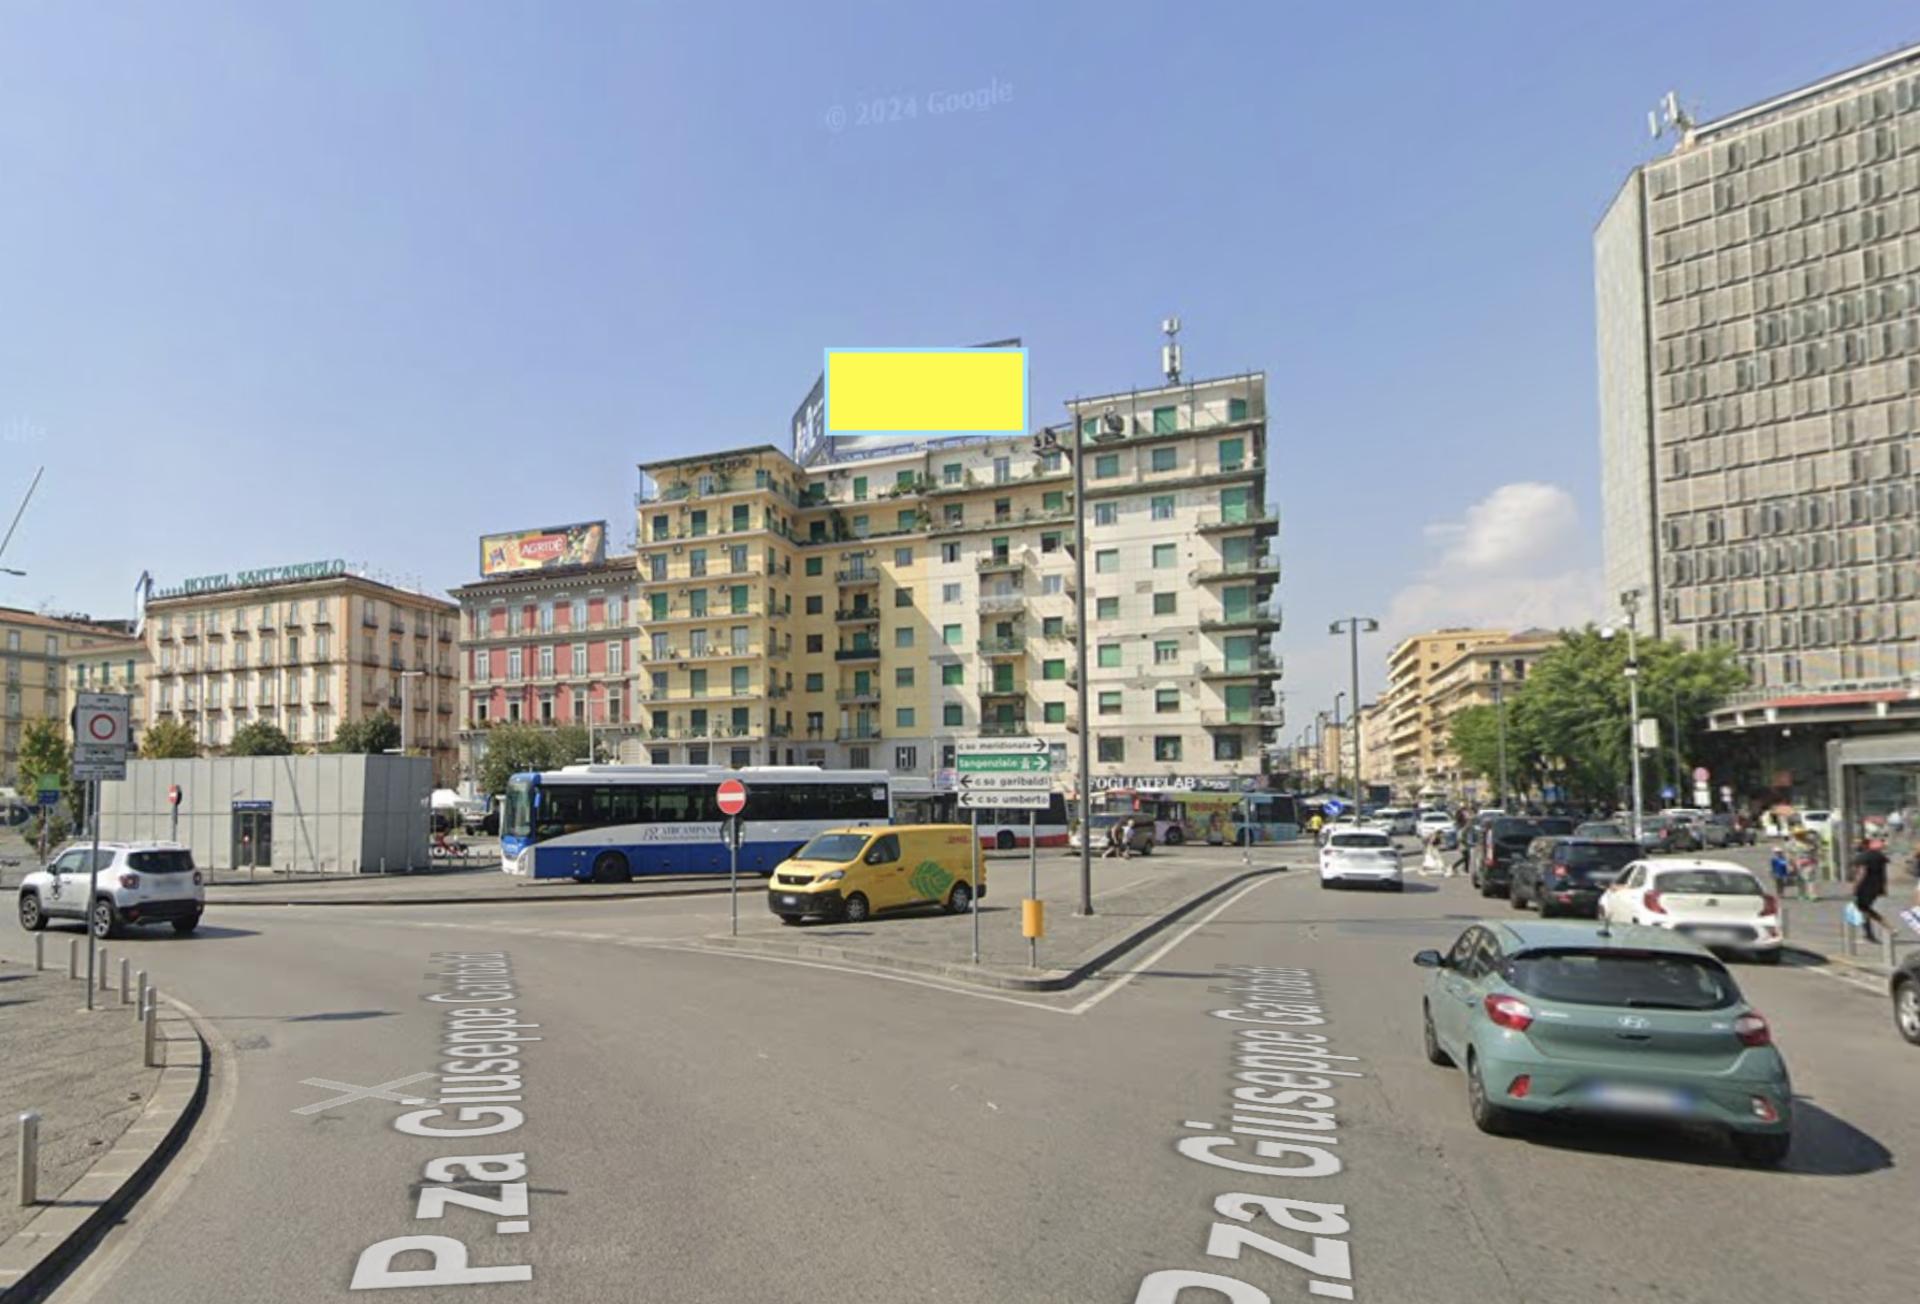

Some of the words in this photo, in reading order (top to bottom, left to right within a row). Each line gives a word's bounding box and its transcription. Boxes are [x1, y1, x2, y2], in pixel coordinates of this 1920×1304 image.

[184, 573, 229, 594] HOTEL
[980, 740, 1031, 750] meridionale
[960, 758, 1018, 769] tangenziale
[1001, 776, 1049, 788] garibaldi
[1088, 776, 1196, 789] FOGLIATELAB
[1002, 795, 1048, 805] umberto
